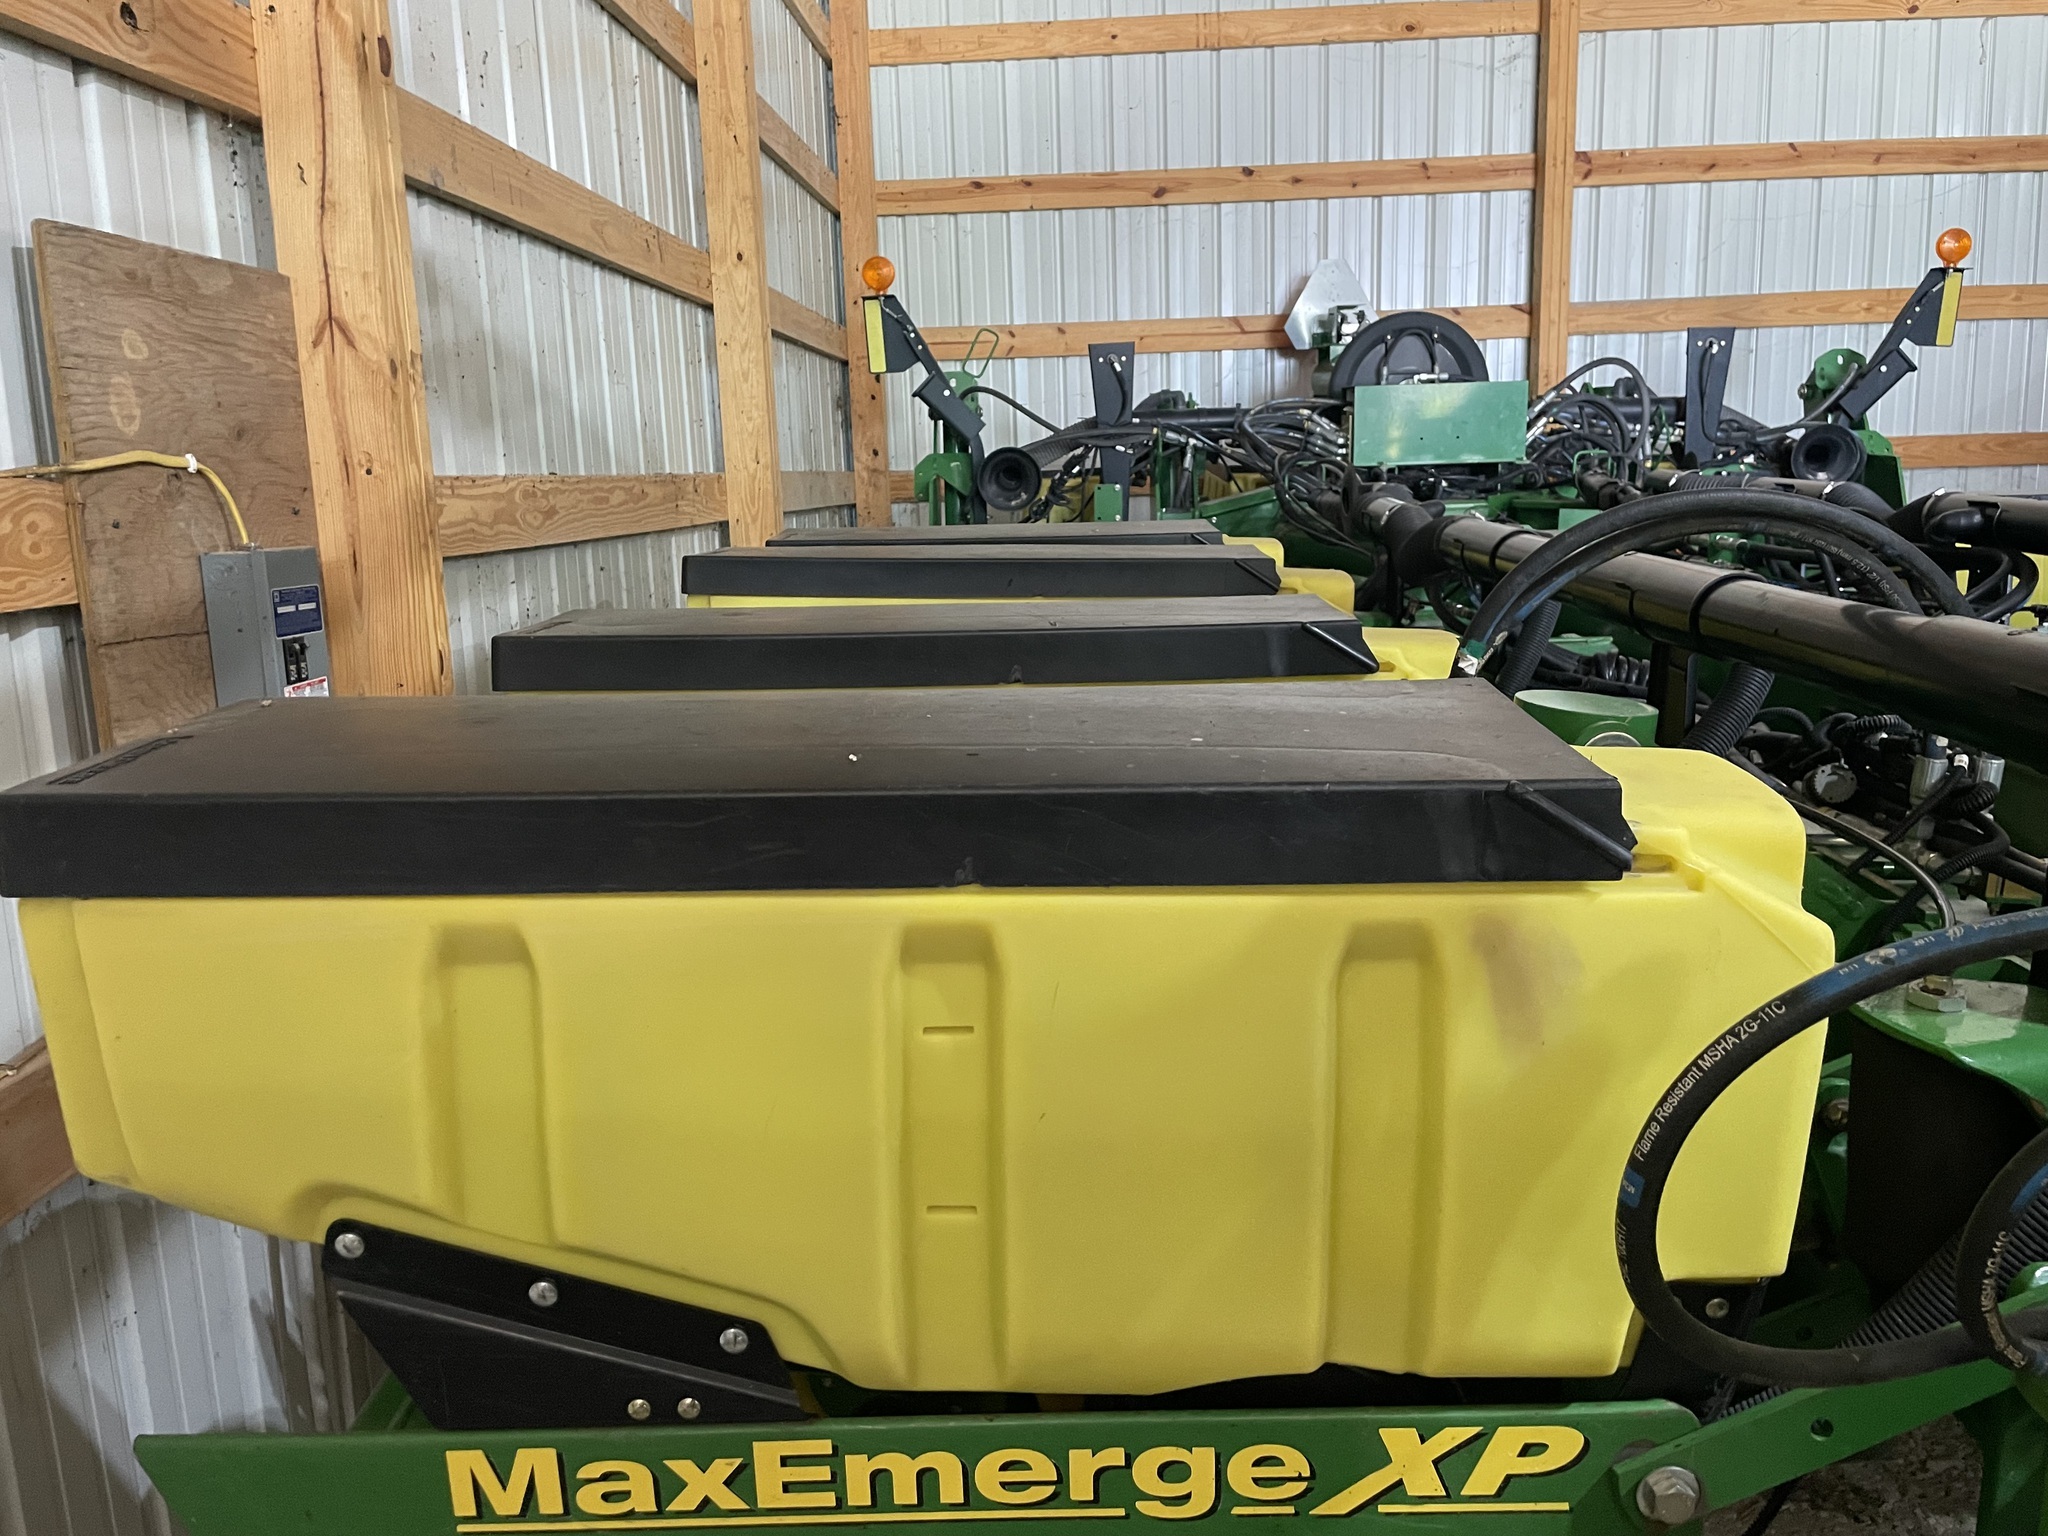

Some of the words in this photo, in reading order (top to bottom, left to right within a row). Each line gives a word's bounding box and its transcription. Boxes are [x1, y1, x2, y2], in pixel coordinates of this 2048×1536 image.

[1633, 1121, 1661, 1162] Flame
[1654, 1066, 1703, 1123] Resistant
[1697, 1034, 1740, 1071] MSHA
[1734, 1000, 1787, 1041] 2G-11C
[445, 1440, 1311, 1519] MaxEmerge
[1308, 1425, 1586, 1516] XP
